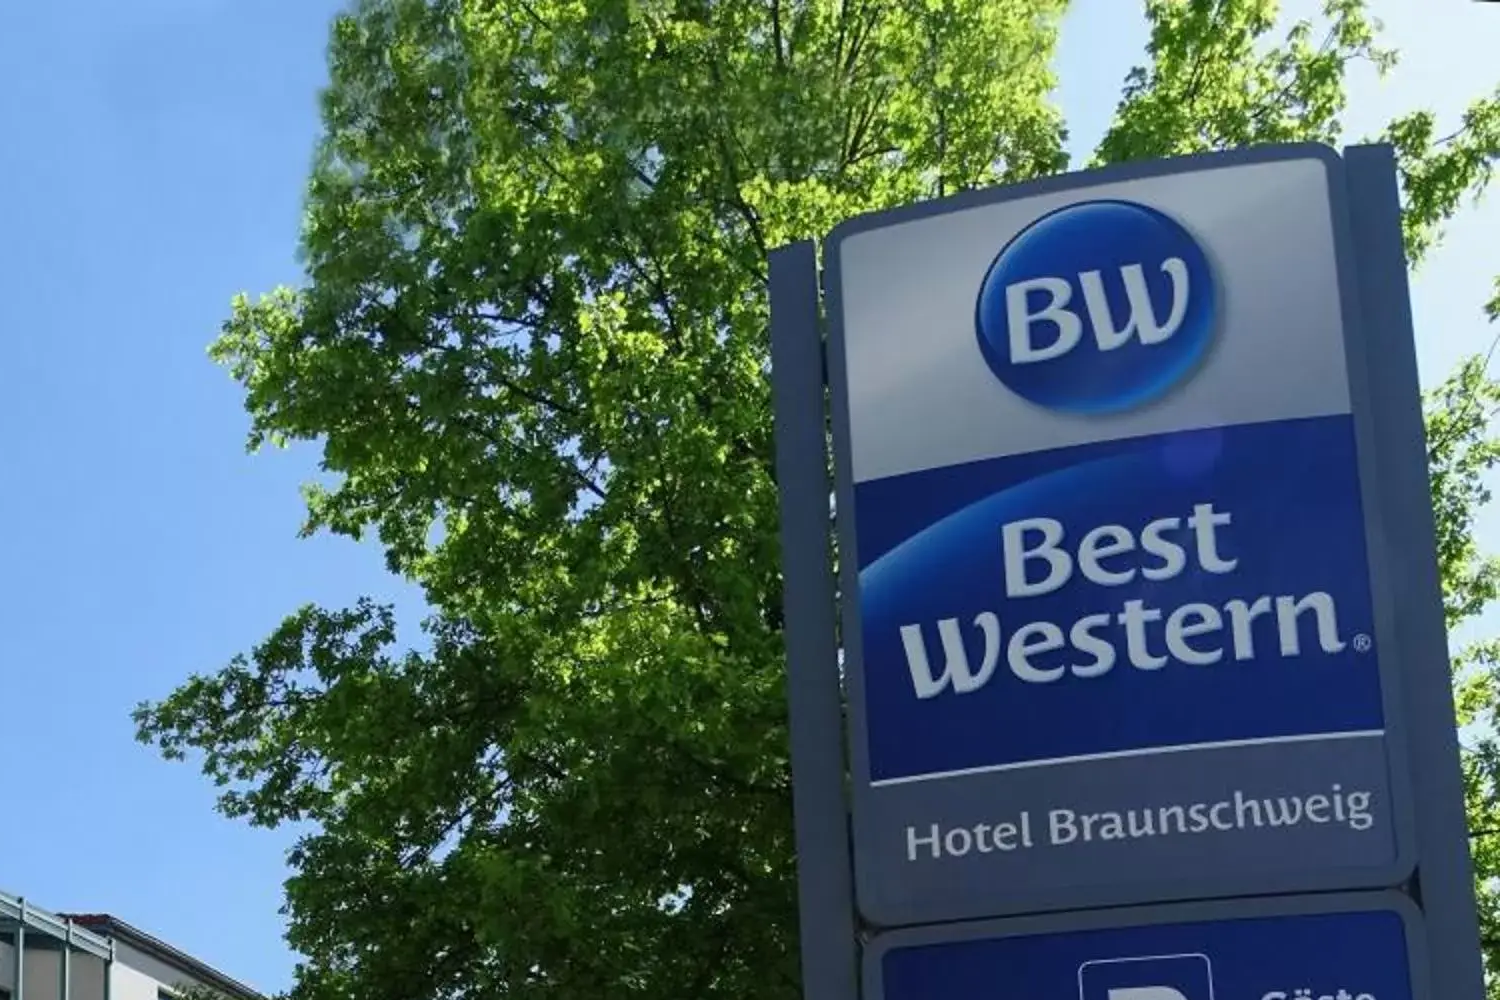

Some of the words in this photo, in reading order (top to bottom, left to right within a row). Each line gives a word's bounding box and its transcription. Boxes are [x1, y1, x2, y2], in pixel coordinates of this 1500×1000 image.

[1005, 257, 1190, 365] BW
[1002, 503, 1239, 599] Best
[905, 811, 1033, 861] Hotel
[1048, 783, 1375, 846] Braunschweig
